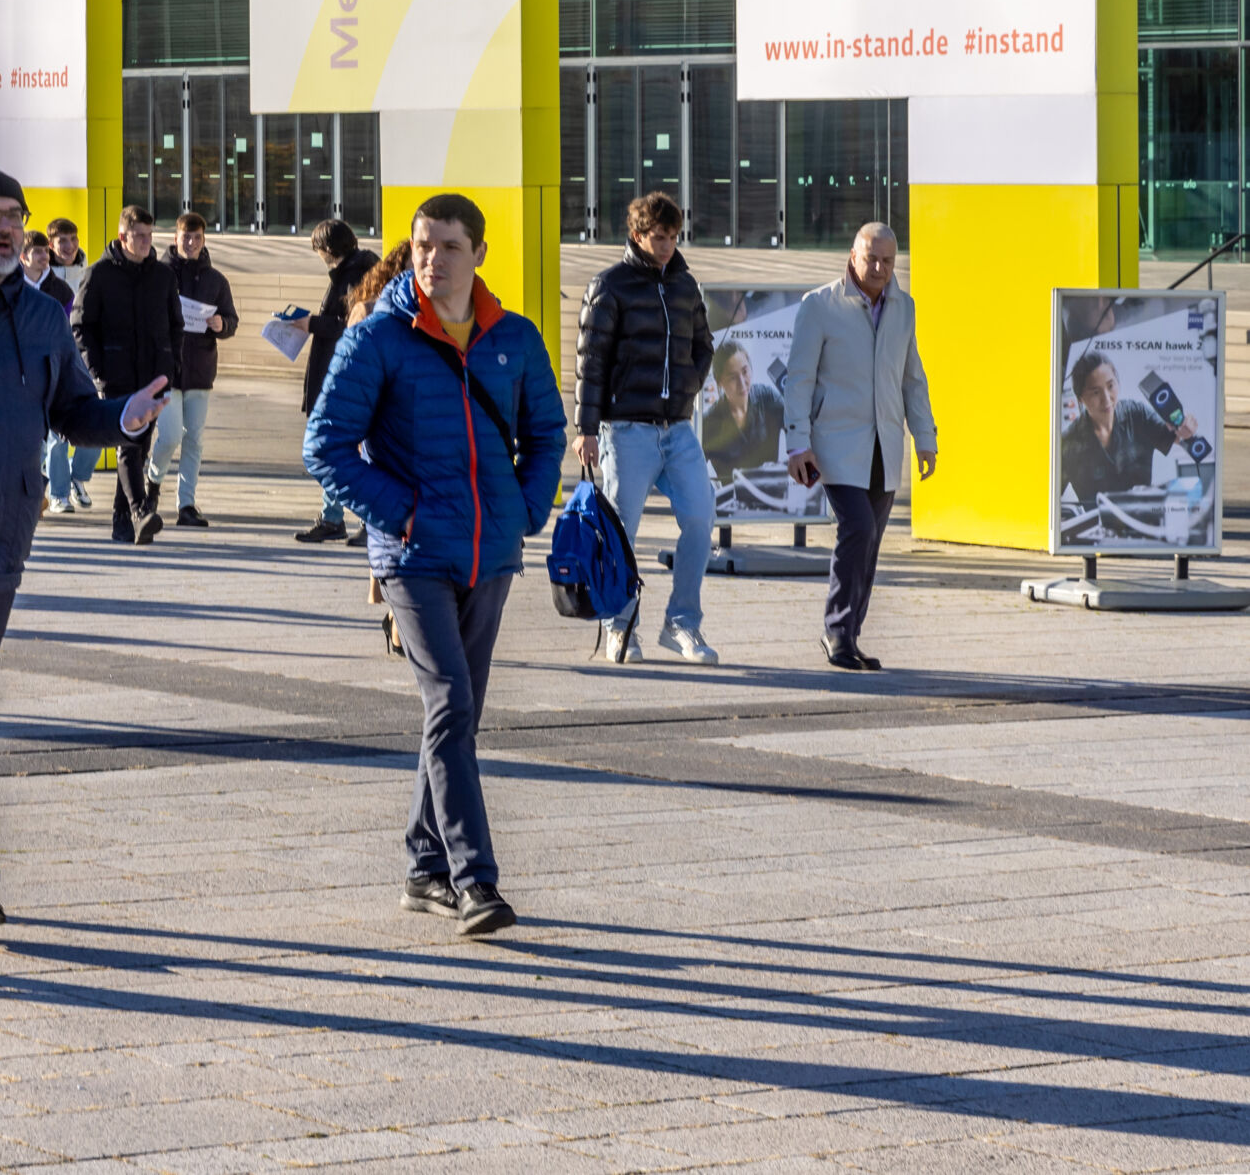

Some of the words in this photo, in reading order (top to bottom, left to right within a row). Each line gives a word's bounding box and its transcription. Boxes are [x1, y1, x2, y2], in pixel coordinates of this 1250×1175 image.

[765, 27, 948, 61] www.in-stand.de
[964, 23, 1064, 54] #instand
[10, 65, 68, 89] #instand
[730, 330, 754, 339] ZEISS
[1094, 341, 1122, 350] ZEISS
[1165, 340, 1193, 350] hawk
[1196, 341, 1202, 350] 2
